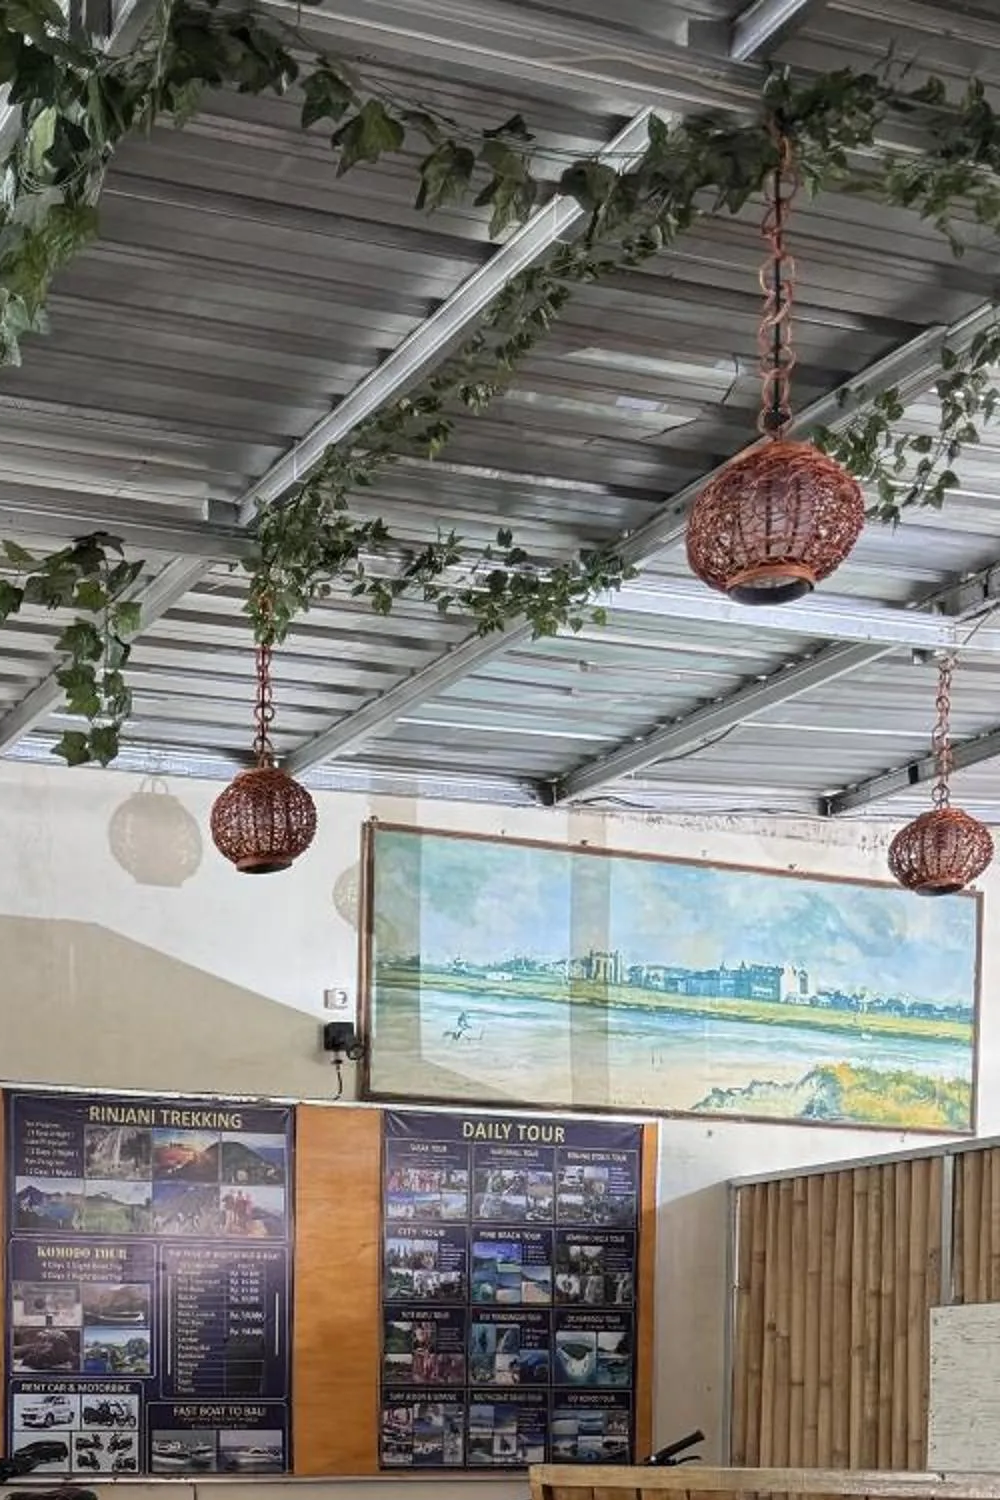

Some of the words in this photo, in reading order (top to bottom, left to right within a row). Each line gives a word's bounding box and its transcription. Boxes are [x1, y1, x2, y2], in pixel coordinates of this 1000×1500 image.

[89, 1105, 155, 1125] RINJANI
[161, 1109, 242, 1129] TREKKING
[463, 1121, 513, 1140] DAILY
[518, 1125, 566, 1143] TOUR
[21, 1383, 46, 1392] RENT
[47, 1383, 67, 1392] CAR
[67, 1384, 77, 1393] &
[78, 1383, 132, 1393] MOTORBIKE
[173, 1405, 197, 1417] FAST
[199, 1405, 225, 1417] BOAT
[229, 1406, 241, 1417] TO
[243, 1406, 266, 1417] BALI
